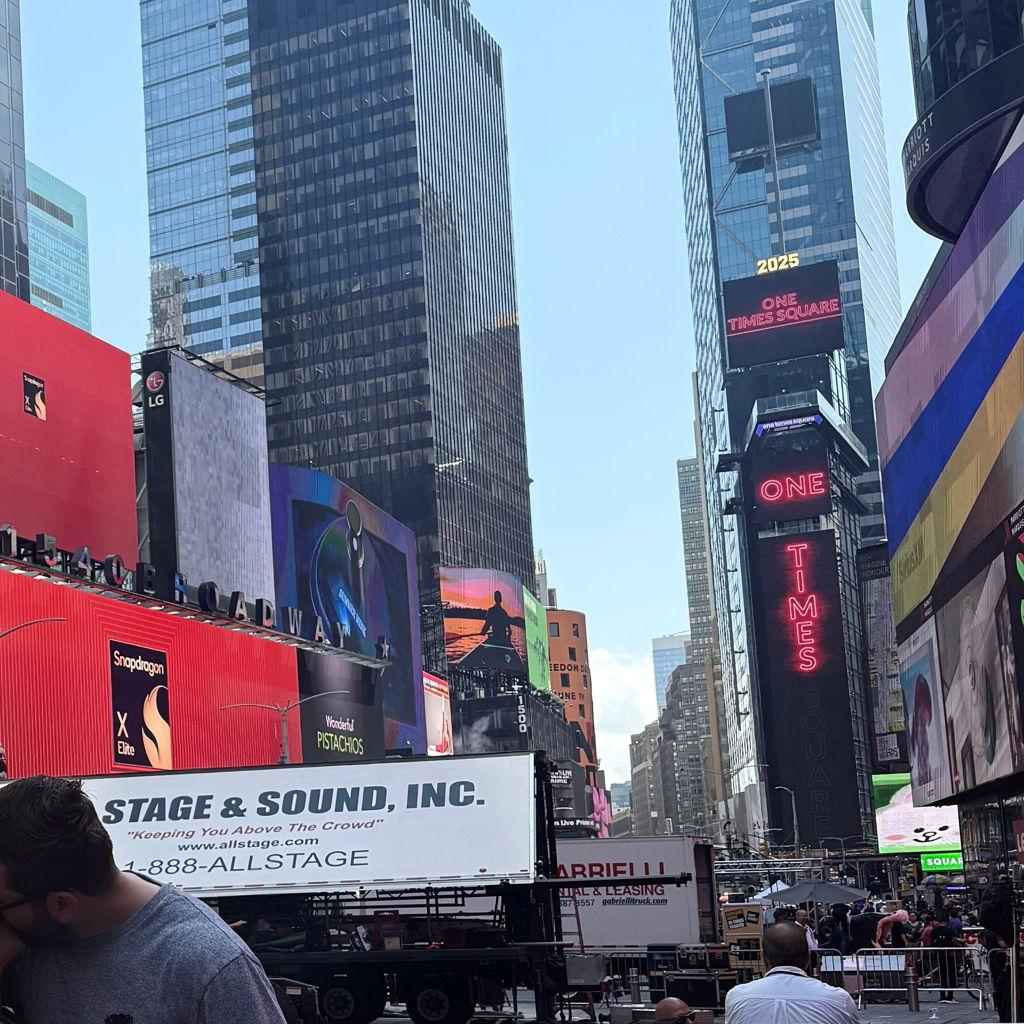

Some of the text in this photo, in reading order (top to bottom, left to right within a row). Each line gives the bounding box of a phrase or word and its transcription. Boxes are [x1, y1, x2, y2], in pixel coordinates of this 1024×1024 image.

[756, 252, 800, 276] 2025
[762, 292, 798, 310] ONE
[728, 298, 840, 331] TIMES SQUARE
[148, 394, 164, 408] LG
[760, 472, 826, 501] ONE
[136, 561, 346, 649] BROADWAY
[787, 542, 819, 672] TIMES
[114, 650, 164, 677] Snapdragon
[117, 711, 129, 738] X
[325, 715, 355, 732] Wonderful
[518, 695, 527, 733] 1500
[117, 740, 135, 756] Elite
[317, 731, 364, 755] PISTACHIOS
[102, 780, 486, 824] STAGE & SOUND, INC.
[127, 818, 385, 841] "Keeping You Above The Crowd"
[178, 837, 319, 851] www.allstage.com
[124, 849, 370, 876] 1-888-ALLSTAGE
[593, 885, 602, 896] &
[605, 884, 665, 896] LEASING
[602, 897, 668, 907] gabriellitruck.com
